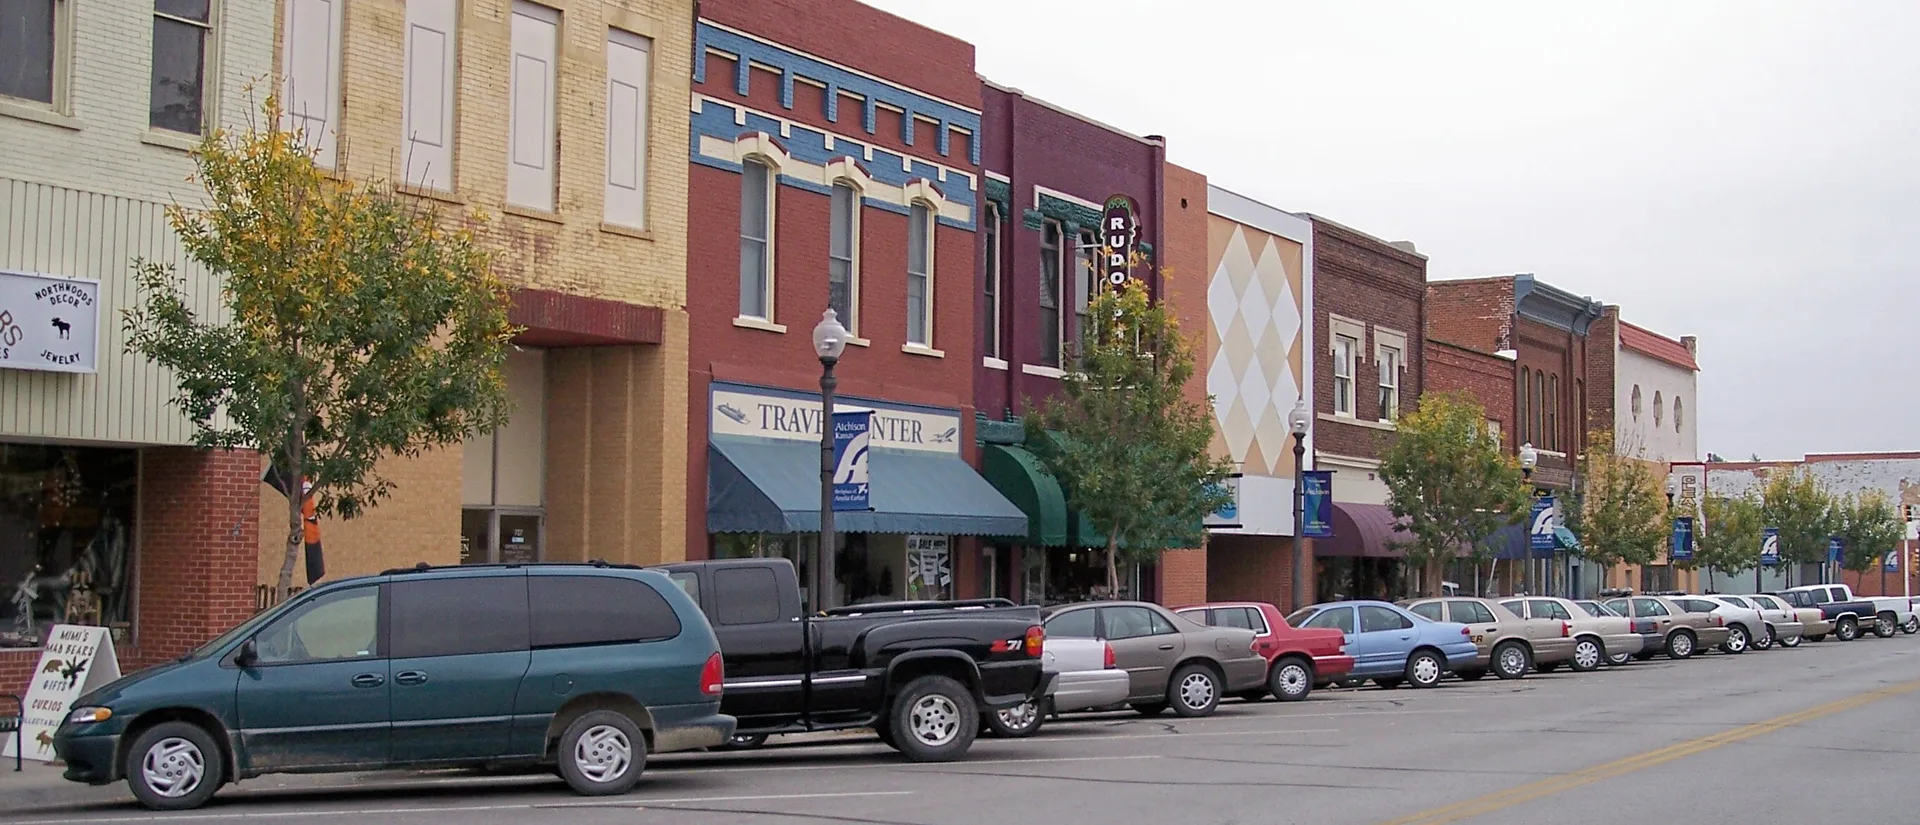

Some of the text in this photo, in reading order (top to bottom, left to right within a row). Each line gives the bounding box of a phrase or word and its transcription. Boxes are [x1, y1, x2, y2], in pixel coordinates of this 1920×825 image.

[35, 282, 93, 307] NORTHWOODS
[49, 294, 80, 308] DECOR
[40, 349, 81, 365] JEWELRY
[757, 403, 924, 445] TRAVE NTER
[834, 422, 867, 432] Atchison
[60, 629, 90, 642] MIMI'S
[65, 644, 95, 657] BEARS
[43, 680, 68, 692] GIFTS
[31, 698, 63, 712] CURIOS
